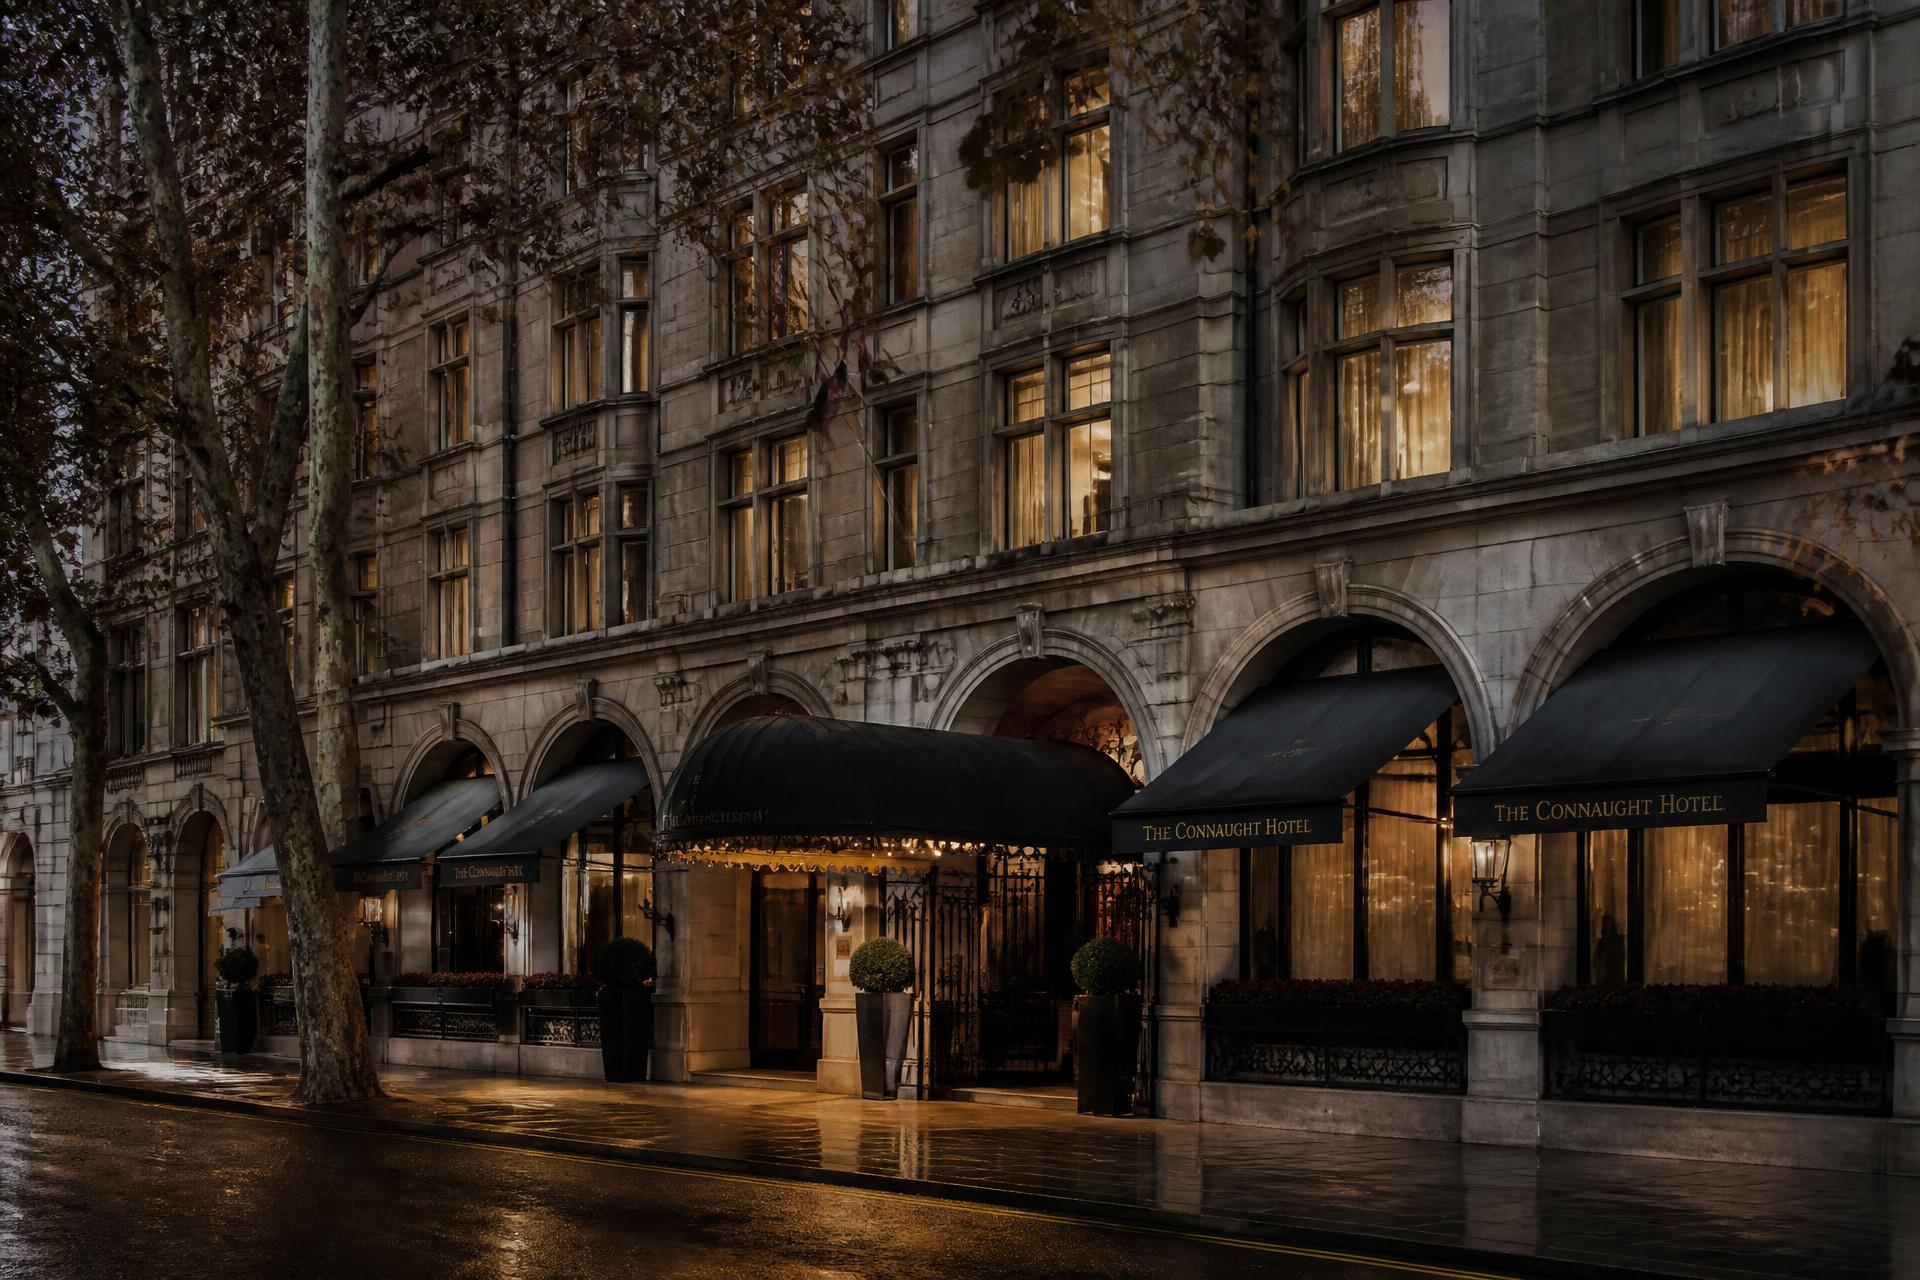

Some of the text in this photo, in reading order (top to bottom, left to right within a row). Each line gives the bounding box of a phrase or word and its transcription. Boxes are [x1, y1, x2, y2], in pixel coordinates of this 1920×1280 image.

[1494, 793, 1725, 822] THE CONNAUGHT HOTEL
[1142, 818, 1312, 841] THE CONNAUGHT HOTEL
